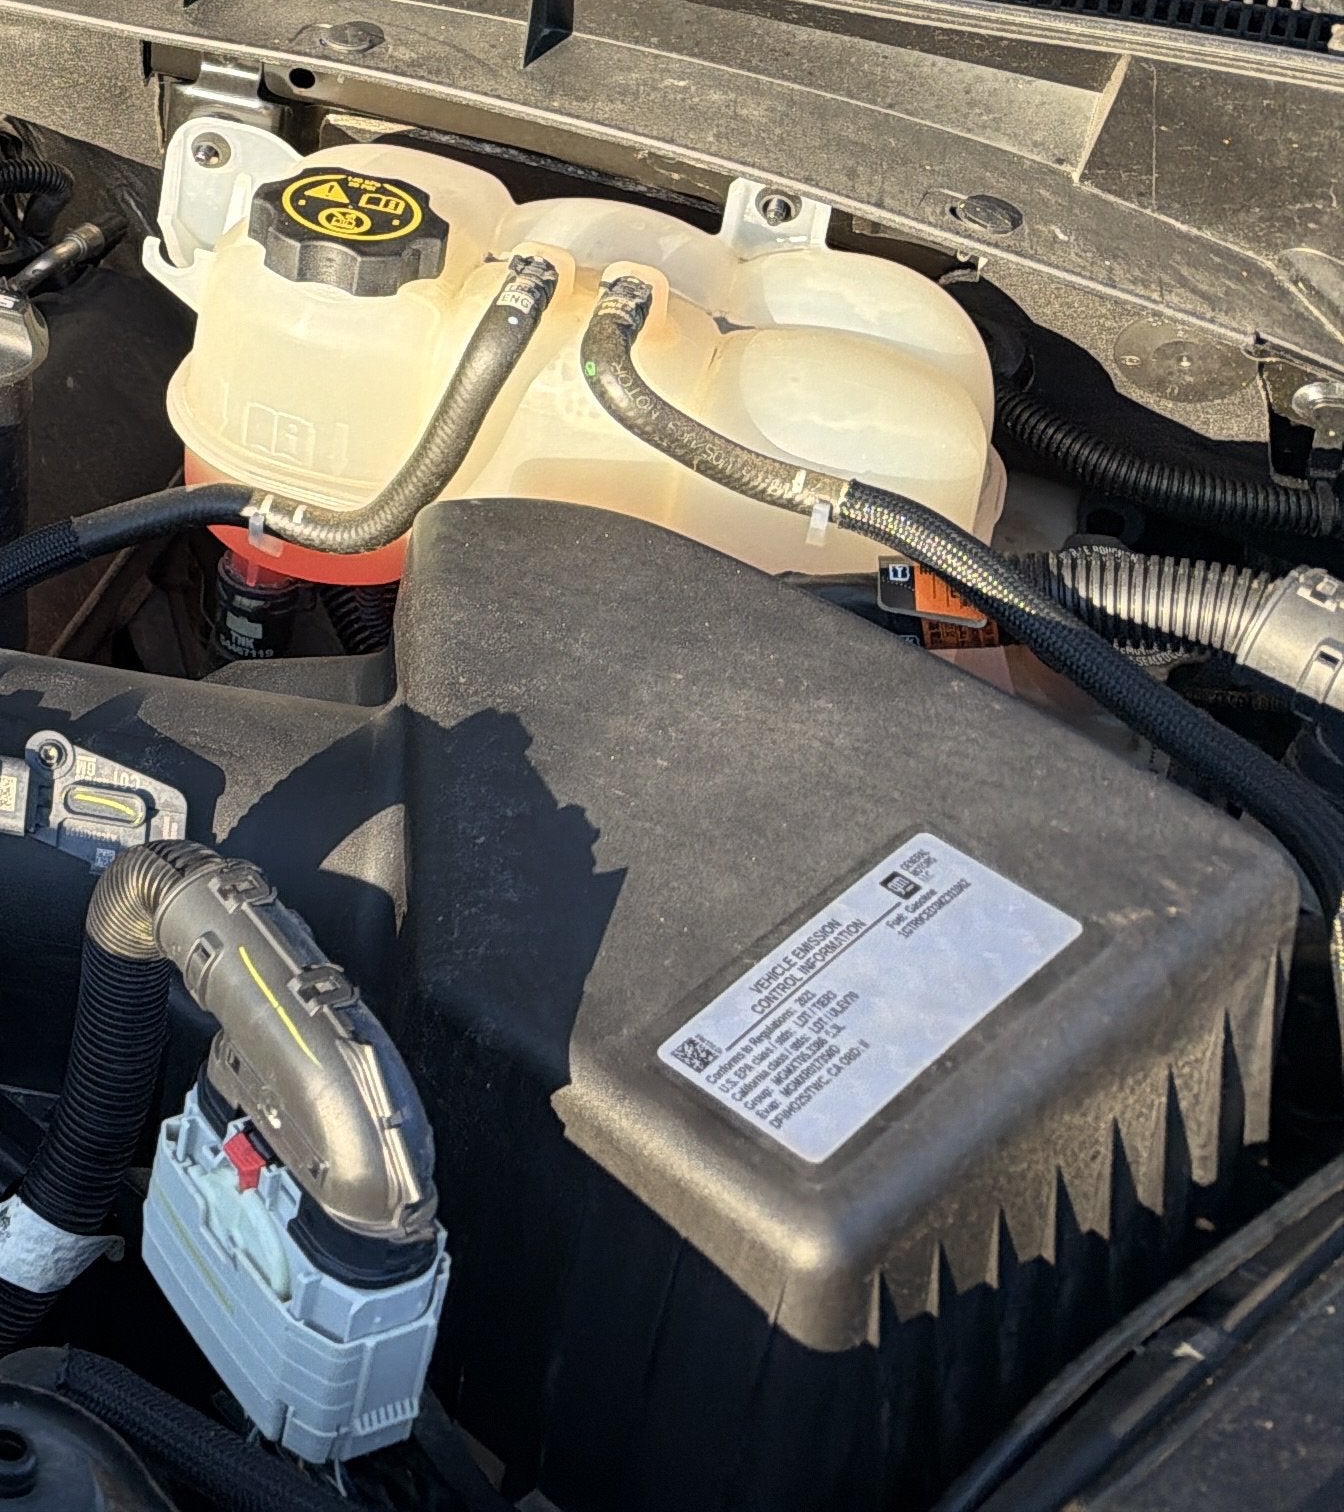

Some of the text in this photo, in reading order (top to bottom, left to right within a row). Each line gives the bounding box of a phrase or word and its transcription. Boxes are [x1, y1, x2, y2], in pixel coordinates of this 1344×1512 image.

[500, 292, 532, 310] ENG
[749, 918, 841, 993] VEHICLE EMISSION
[751, 919, 865, 1014] CONTROL INFORMATION
[705, 1051, 745, 1083] Conforms
[740, 1044, 753, 1053] to
[748, 1008, 796, 1045] Regulations:
[794, 990, 816, 1007] 2021
[718, 1078, 739, 1093] U.S.
[733, 1063, 753, 1079] EPA
[751, 1047, 773, 1065] class
[793, 1010, 811, 1027] LDT
[811, 990, 836, 1009] TIER3
[731, 1070, 770, 1101] California
[767, 1053, 788, 1071] class
[808, 1017, 827, 1033] LDT
[826, 1063, 843, 1076] CA
[743, 1086, 773, 1110] Group:
[755, 1100, 781, 1119] Evap:
